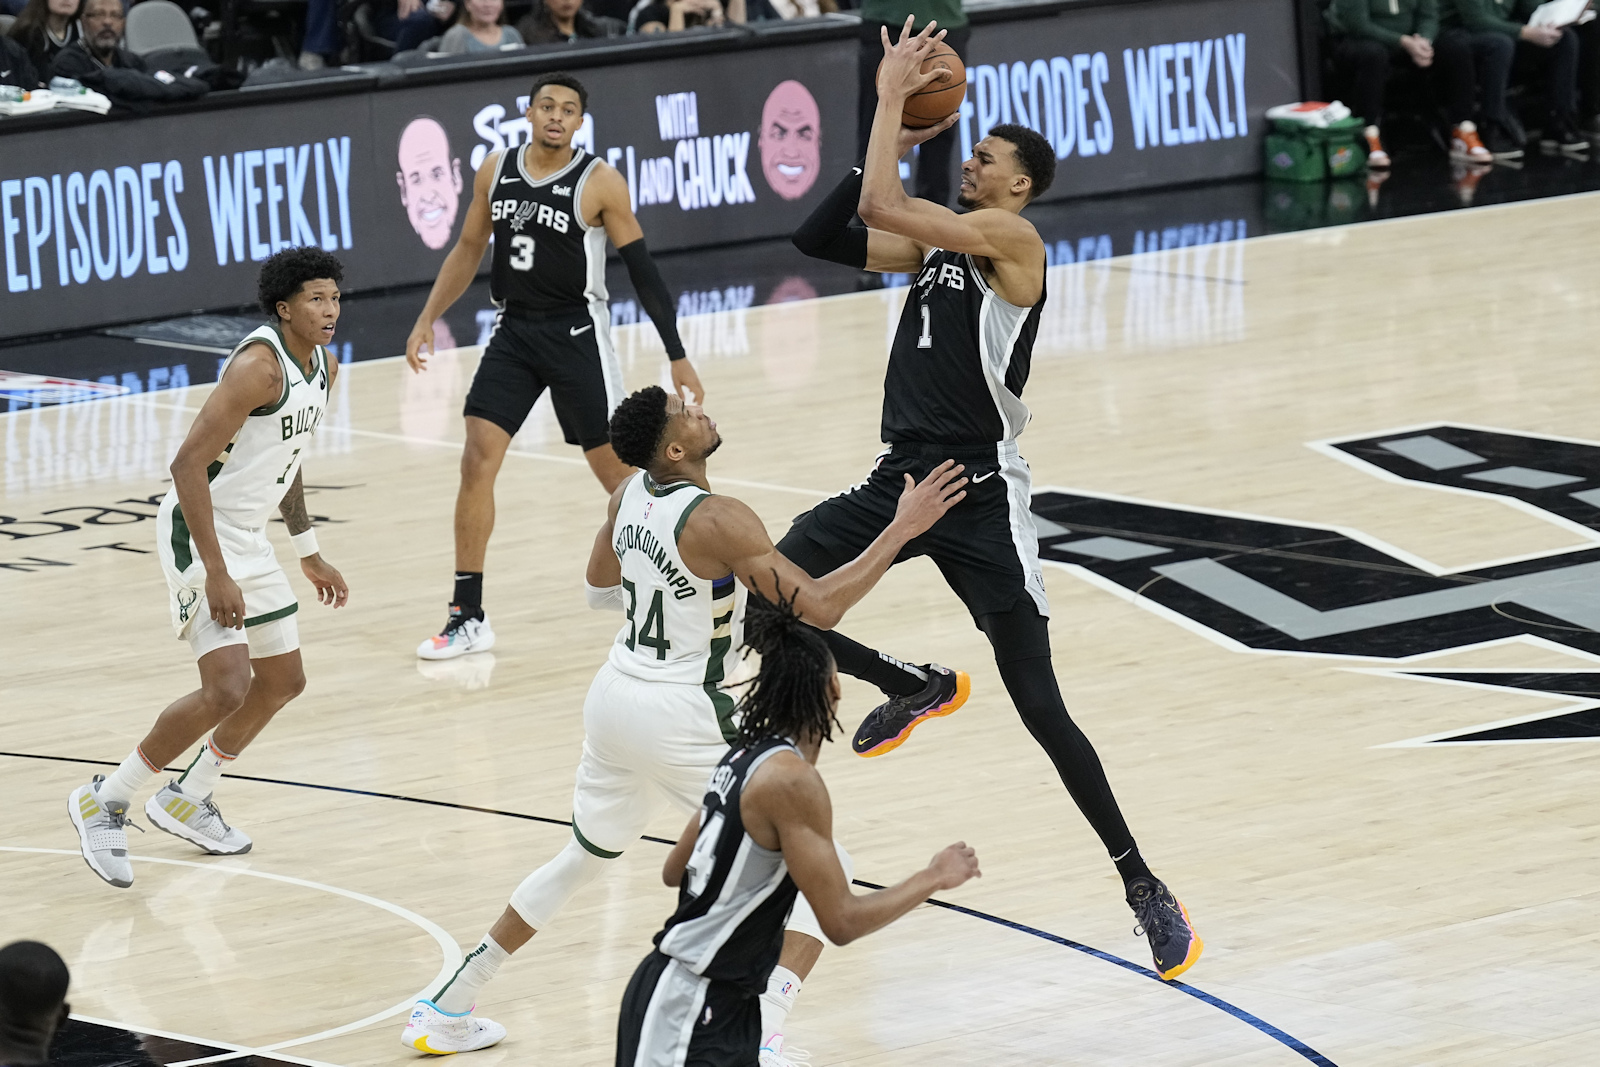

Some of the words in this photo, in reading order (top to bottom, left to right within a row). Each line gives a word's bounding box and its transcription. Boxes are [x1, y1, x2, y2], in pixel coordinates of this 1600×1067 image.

[654, 91, 700, 141] WITH
[958, 51, 1114, 163] EPISODES
[1123, 33, 1249, 151] WEEKLY
[638, 157, 675, 206] AND
[674, 131, 757, 212] CHUCK
[1, 159, 190, 293] EPISODES
[202, 136, 353, 266] WEEKLY
[508, 234, 536, 272] 3
[916, 303, 933, 349] 1
[621, 576, 672, 661] 34
